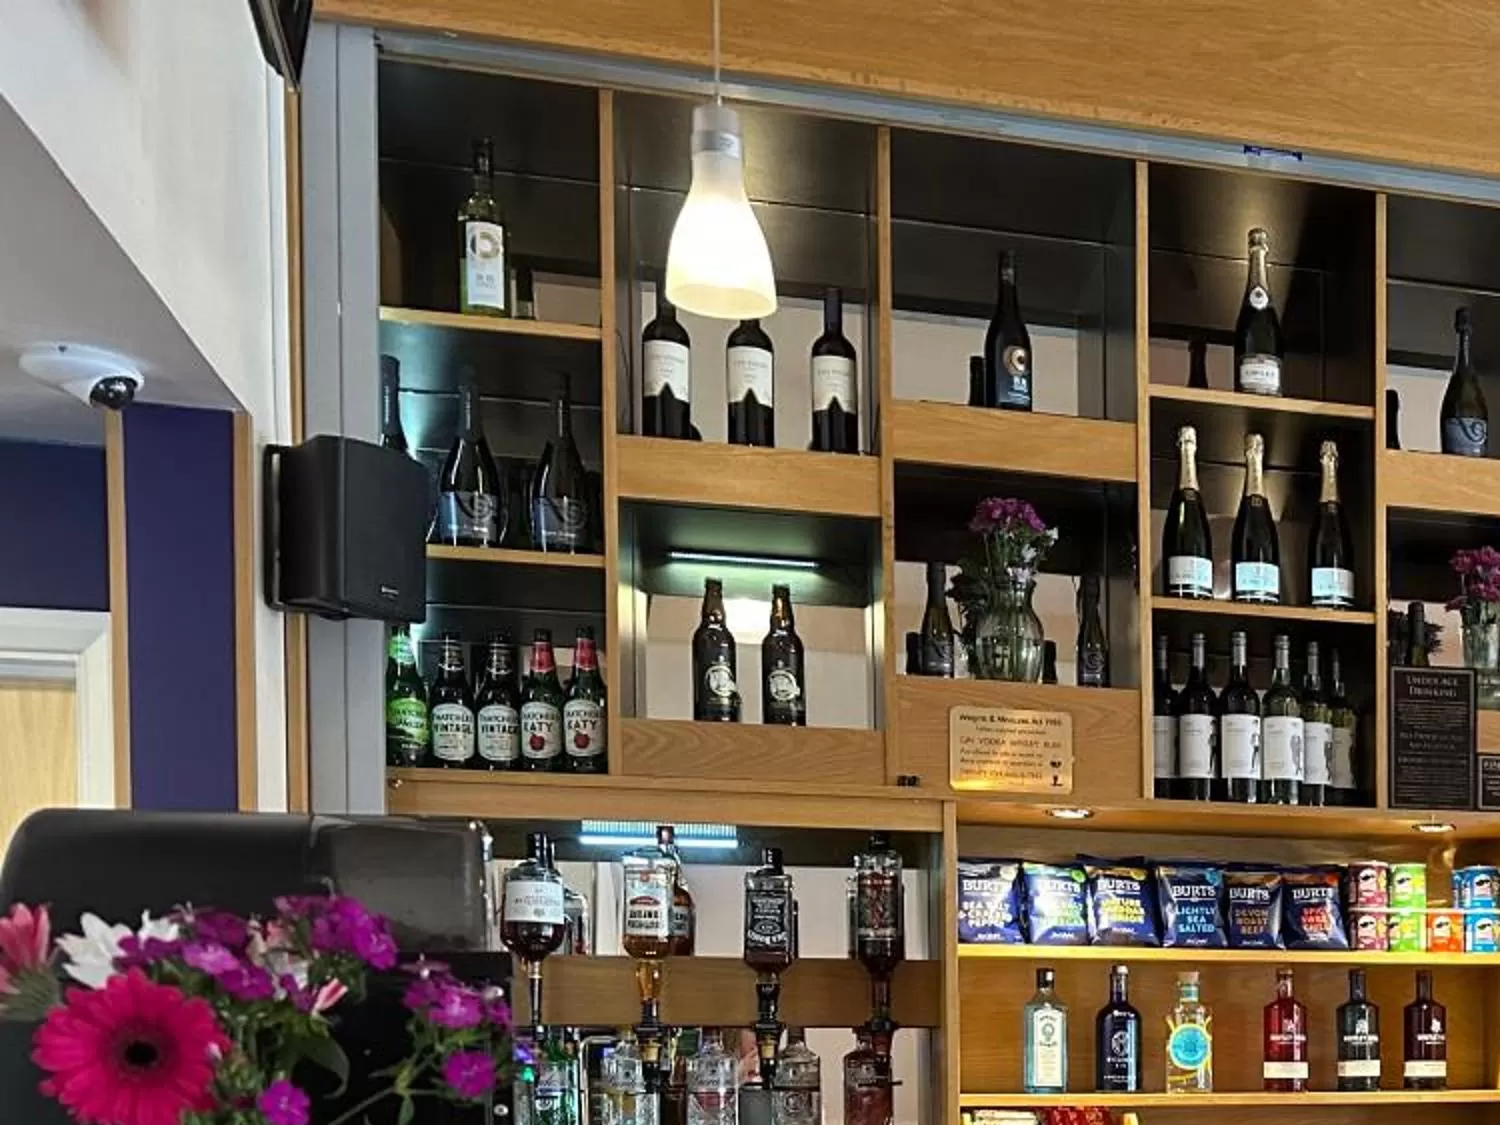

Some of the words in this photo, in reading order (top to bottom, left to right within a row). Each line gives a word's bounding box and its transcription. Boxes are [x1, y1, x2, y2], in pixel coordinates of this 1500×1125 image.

[523, 722, 554, 734] KATY
[1097, 878, 1141, 891] BURTS
[1172, 885, 1217, 898] BURTS
[1229, 887, 1271, 900] BURTS
[1175, 906, 1215, 915] LIGHTLY
[1186, 915, 1207, 924] SEA
[1179, 923, 1215, 934] SALTED
